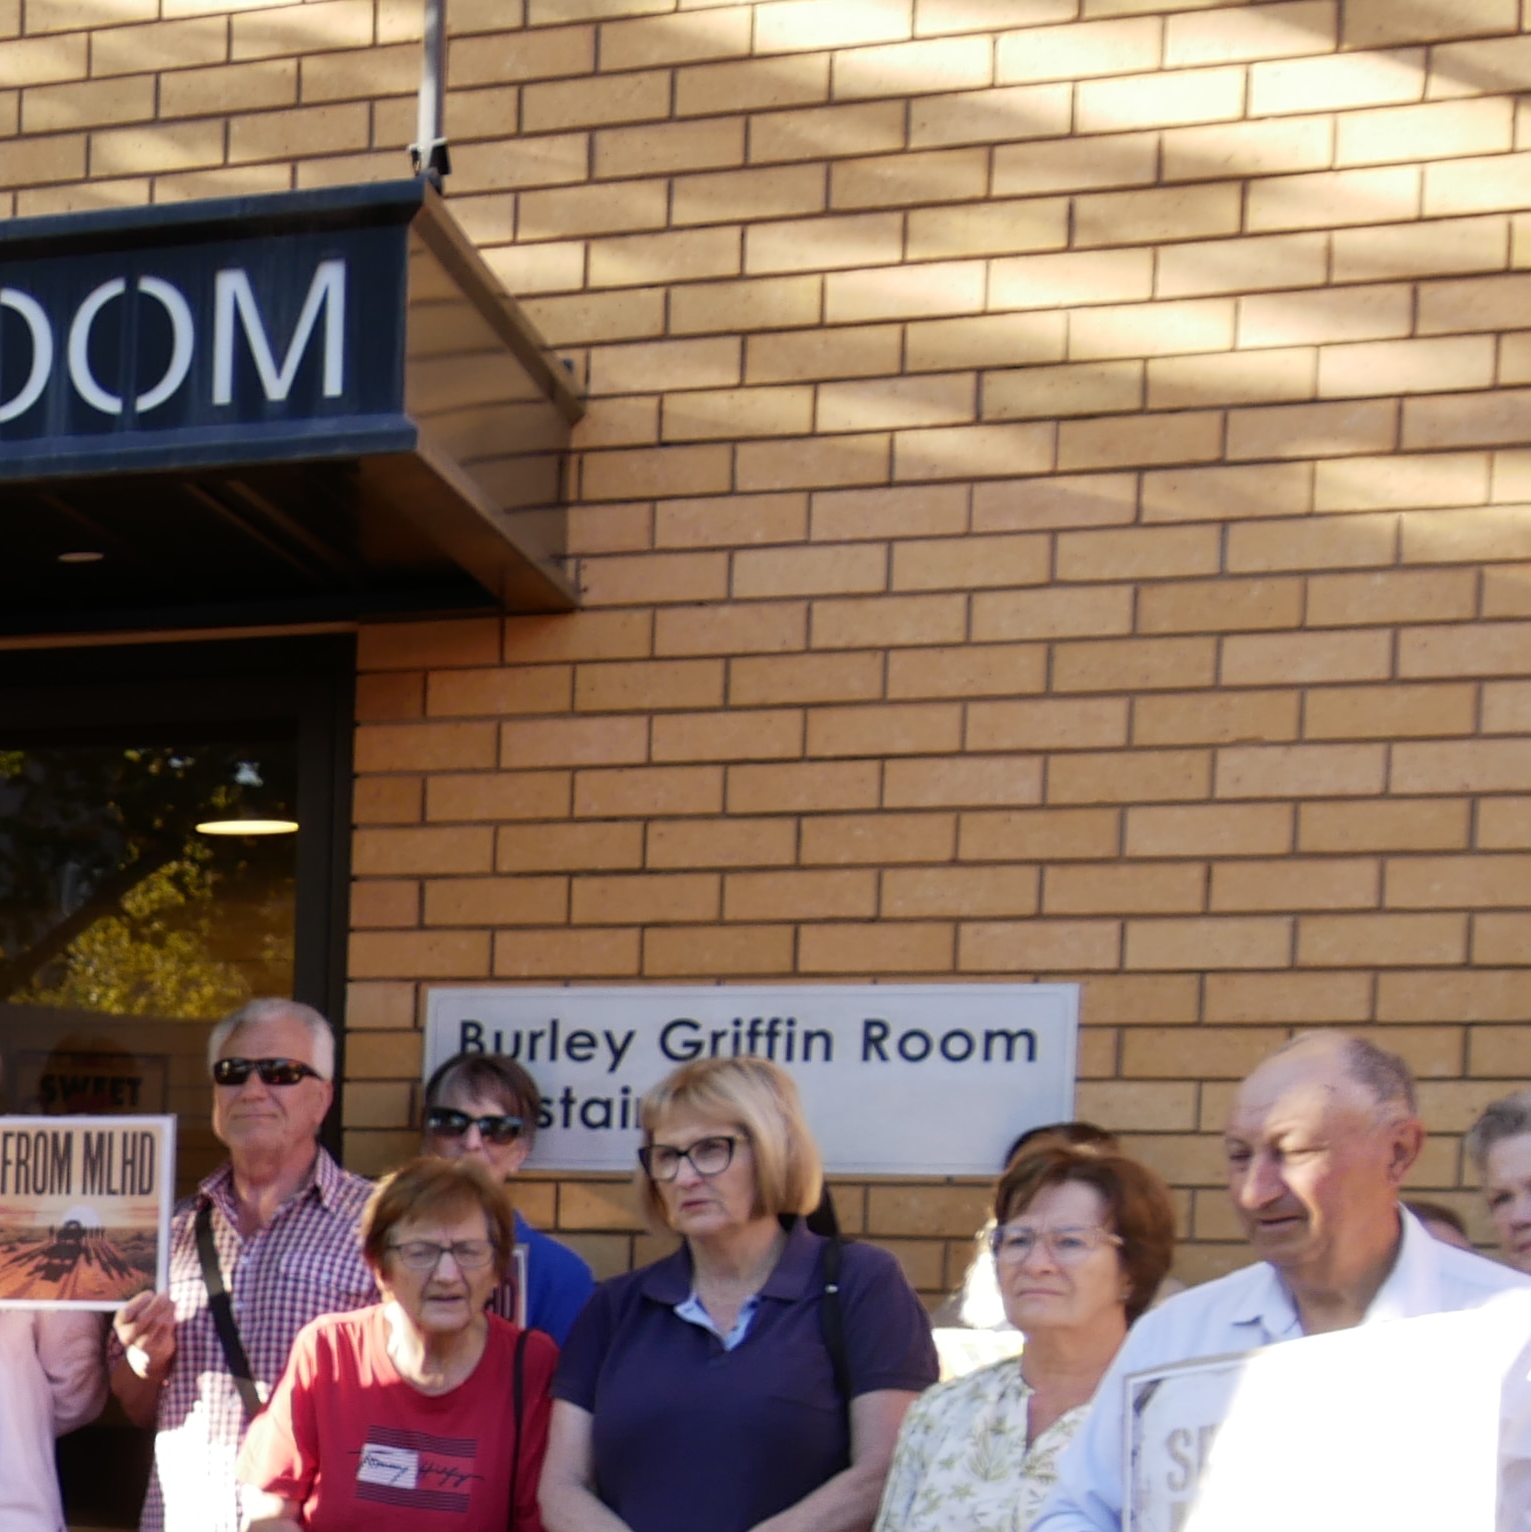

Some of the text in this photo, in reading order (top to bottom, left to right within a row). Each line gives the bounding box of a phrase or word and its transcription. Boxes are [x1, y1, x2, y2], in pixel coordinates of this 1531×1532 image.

[459, 1017, 1038, 1073] Burley Griffin Room
[536, 1086, 645, 1130] stai
[0, 1130, 74, 1196] FROM
[81, 1130, 156, 1196] MLHD
